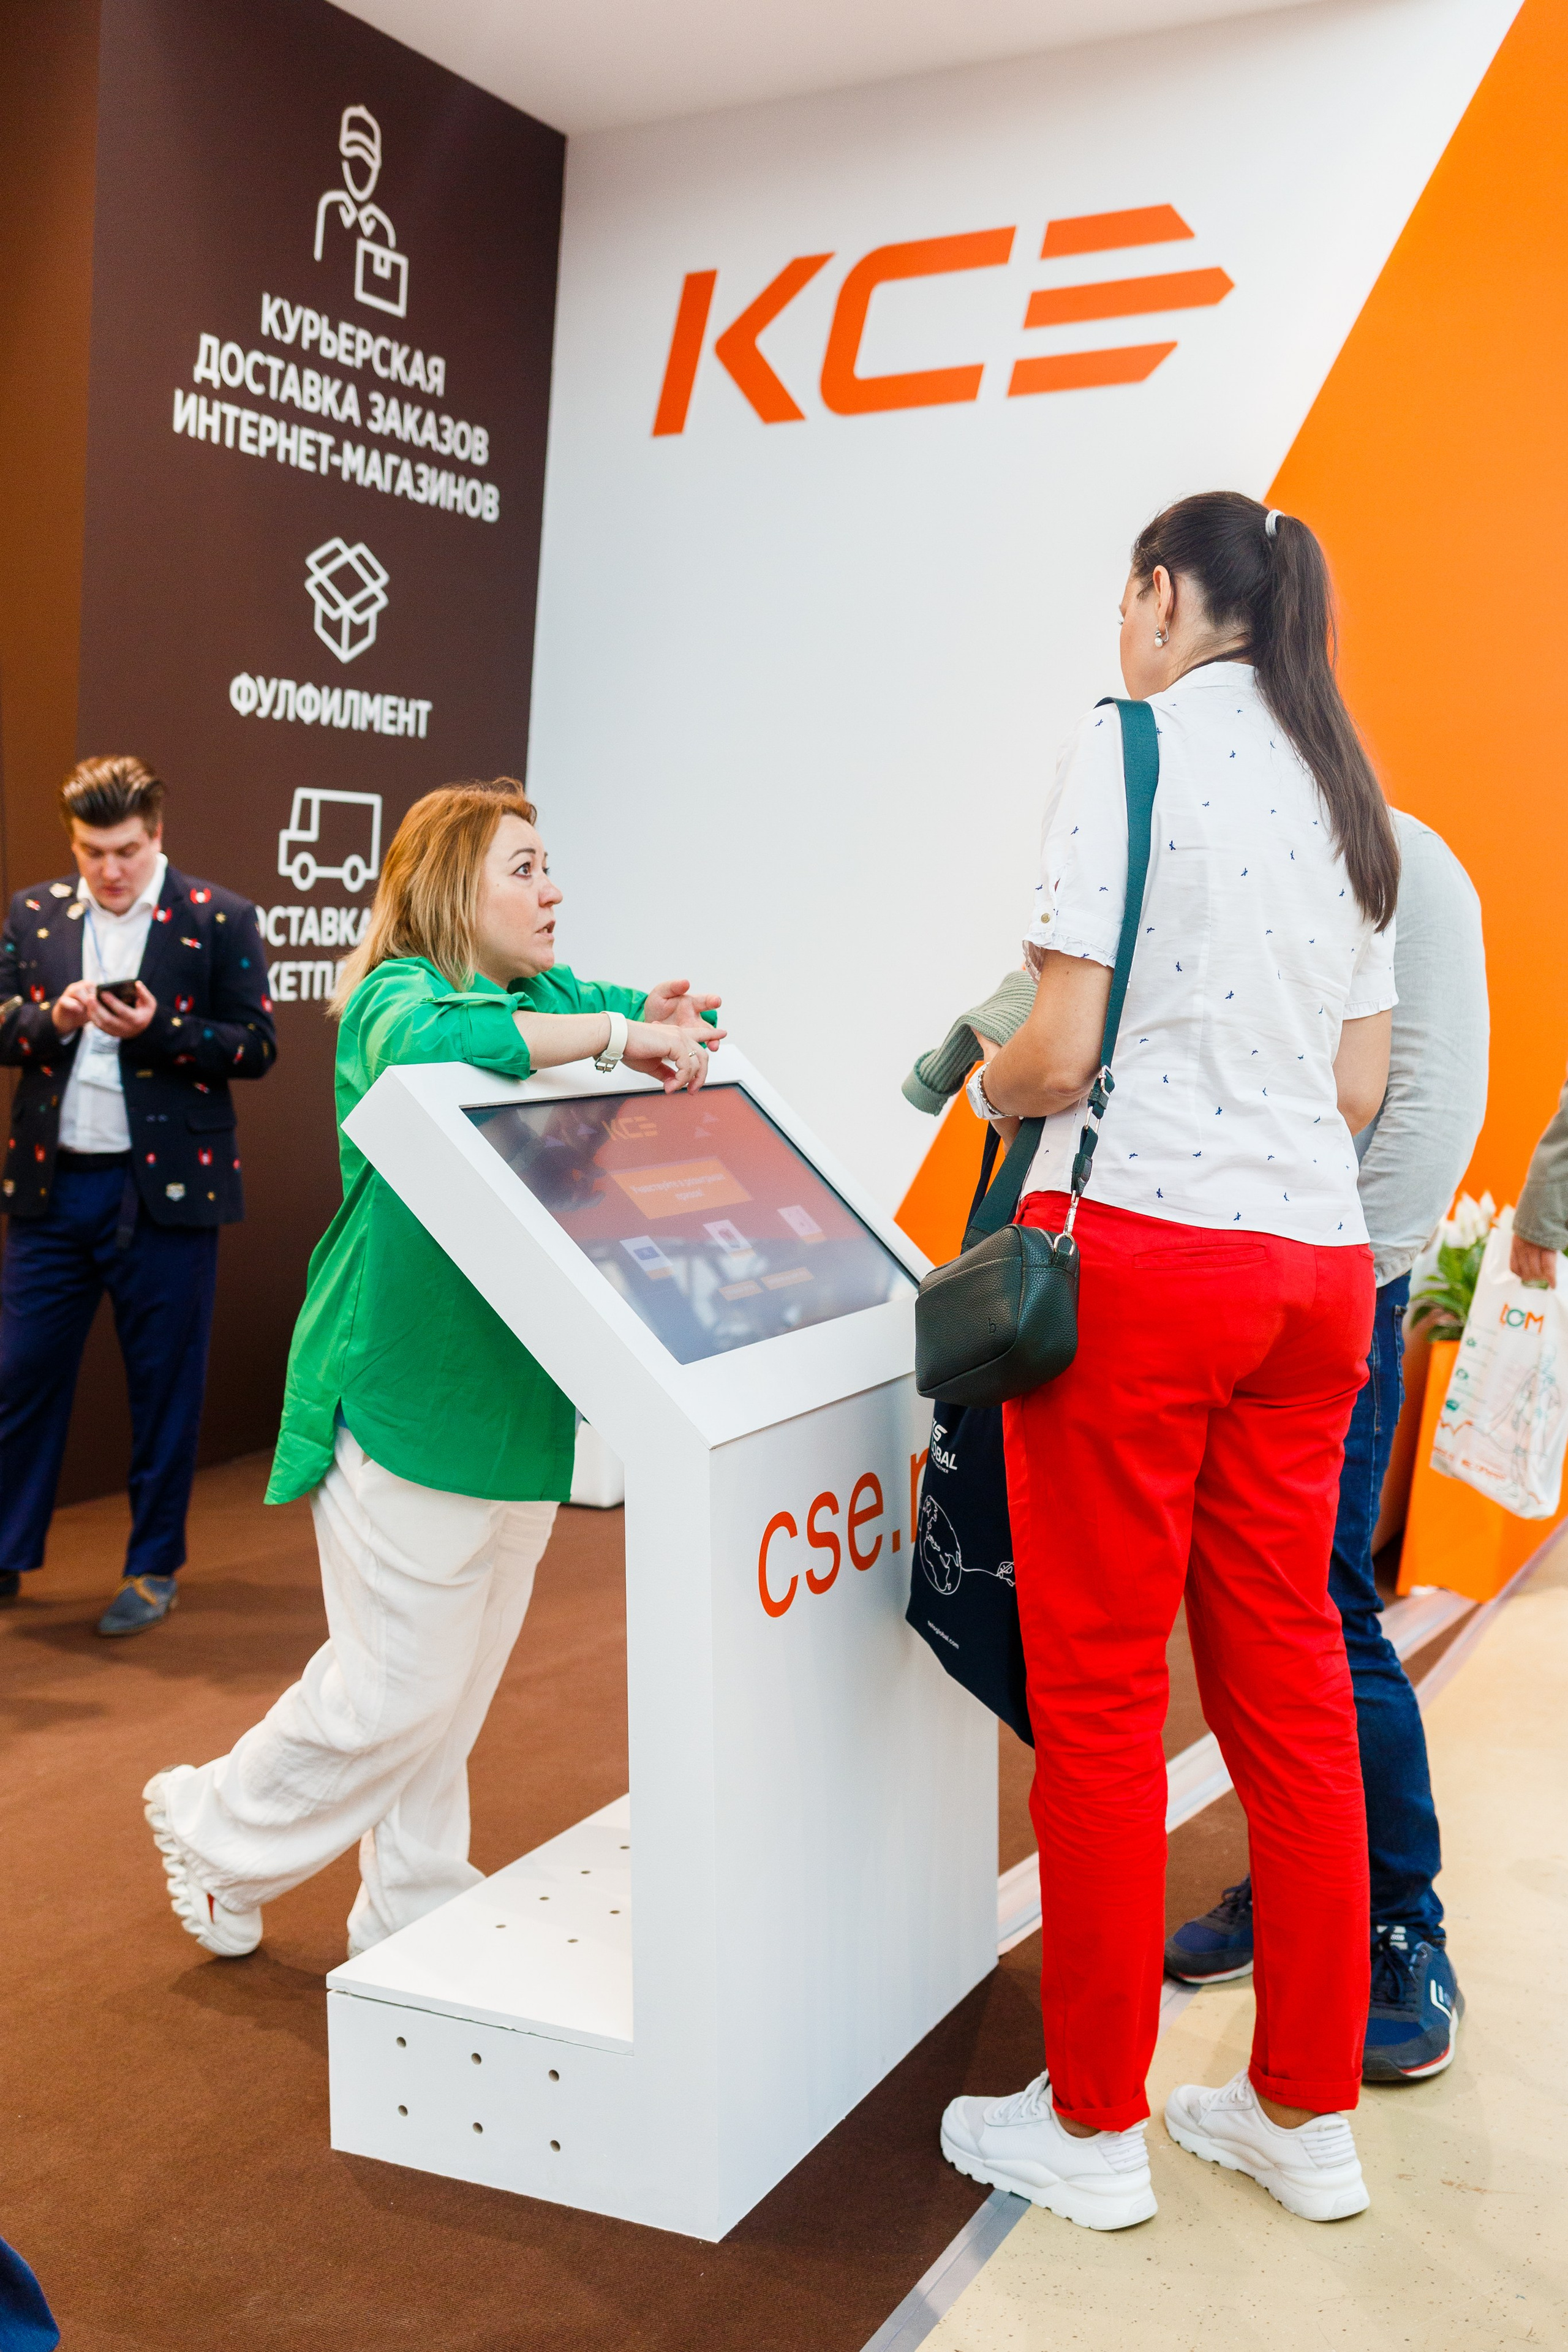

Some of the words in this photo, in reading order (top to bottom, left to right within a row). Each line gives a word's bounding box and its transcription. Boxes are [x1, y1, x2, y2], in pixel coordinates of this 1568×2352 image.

[194, 333, 361, 427] ДОСТАВКА
[367, 392, 489, 466] ЗАКАЗОВ
[262, 293, 445, 396] КУРЬЕРСКАЯ
[173, 388, 500, 522] ИНТЕРНЕТ-МАГАЗИНОВ
[229, 672, 432, 739] ФУЛФИЛМЕНТ
